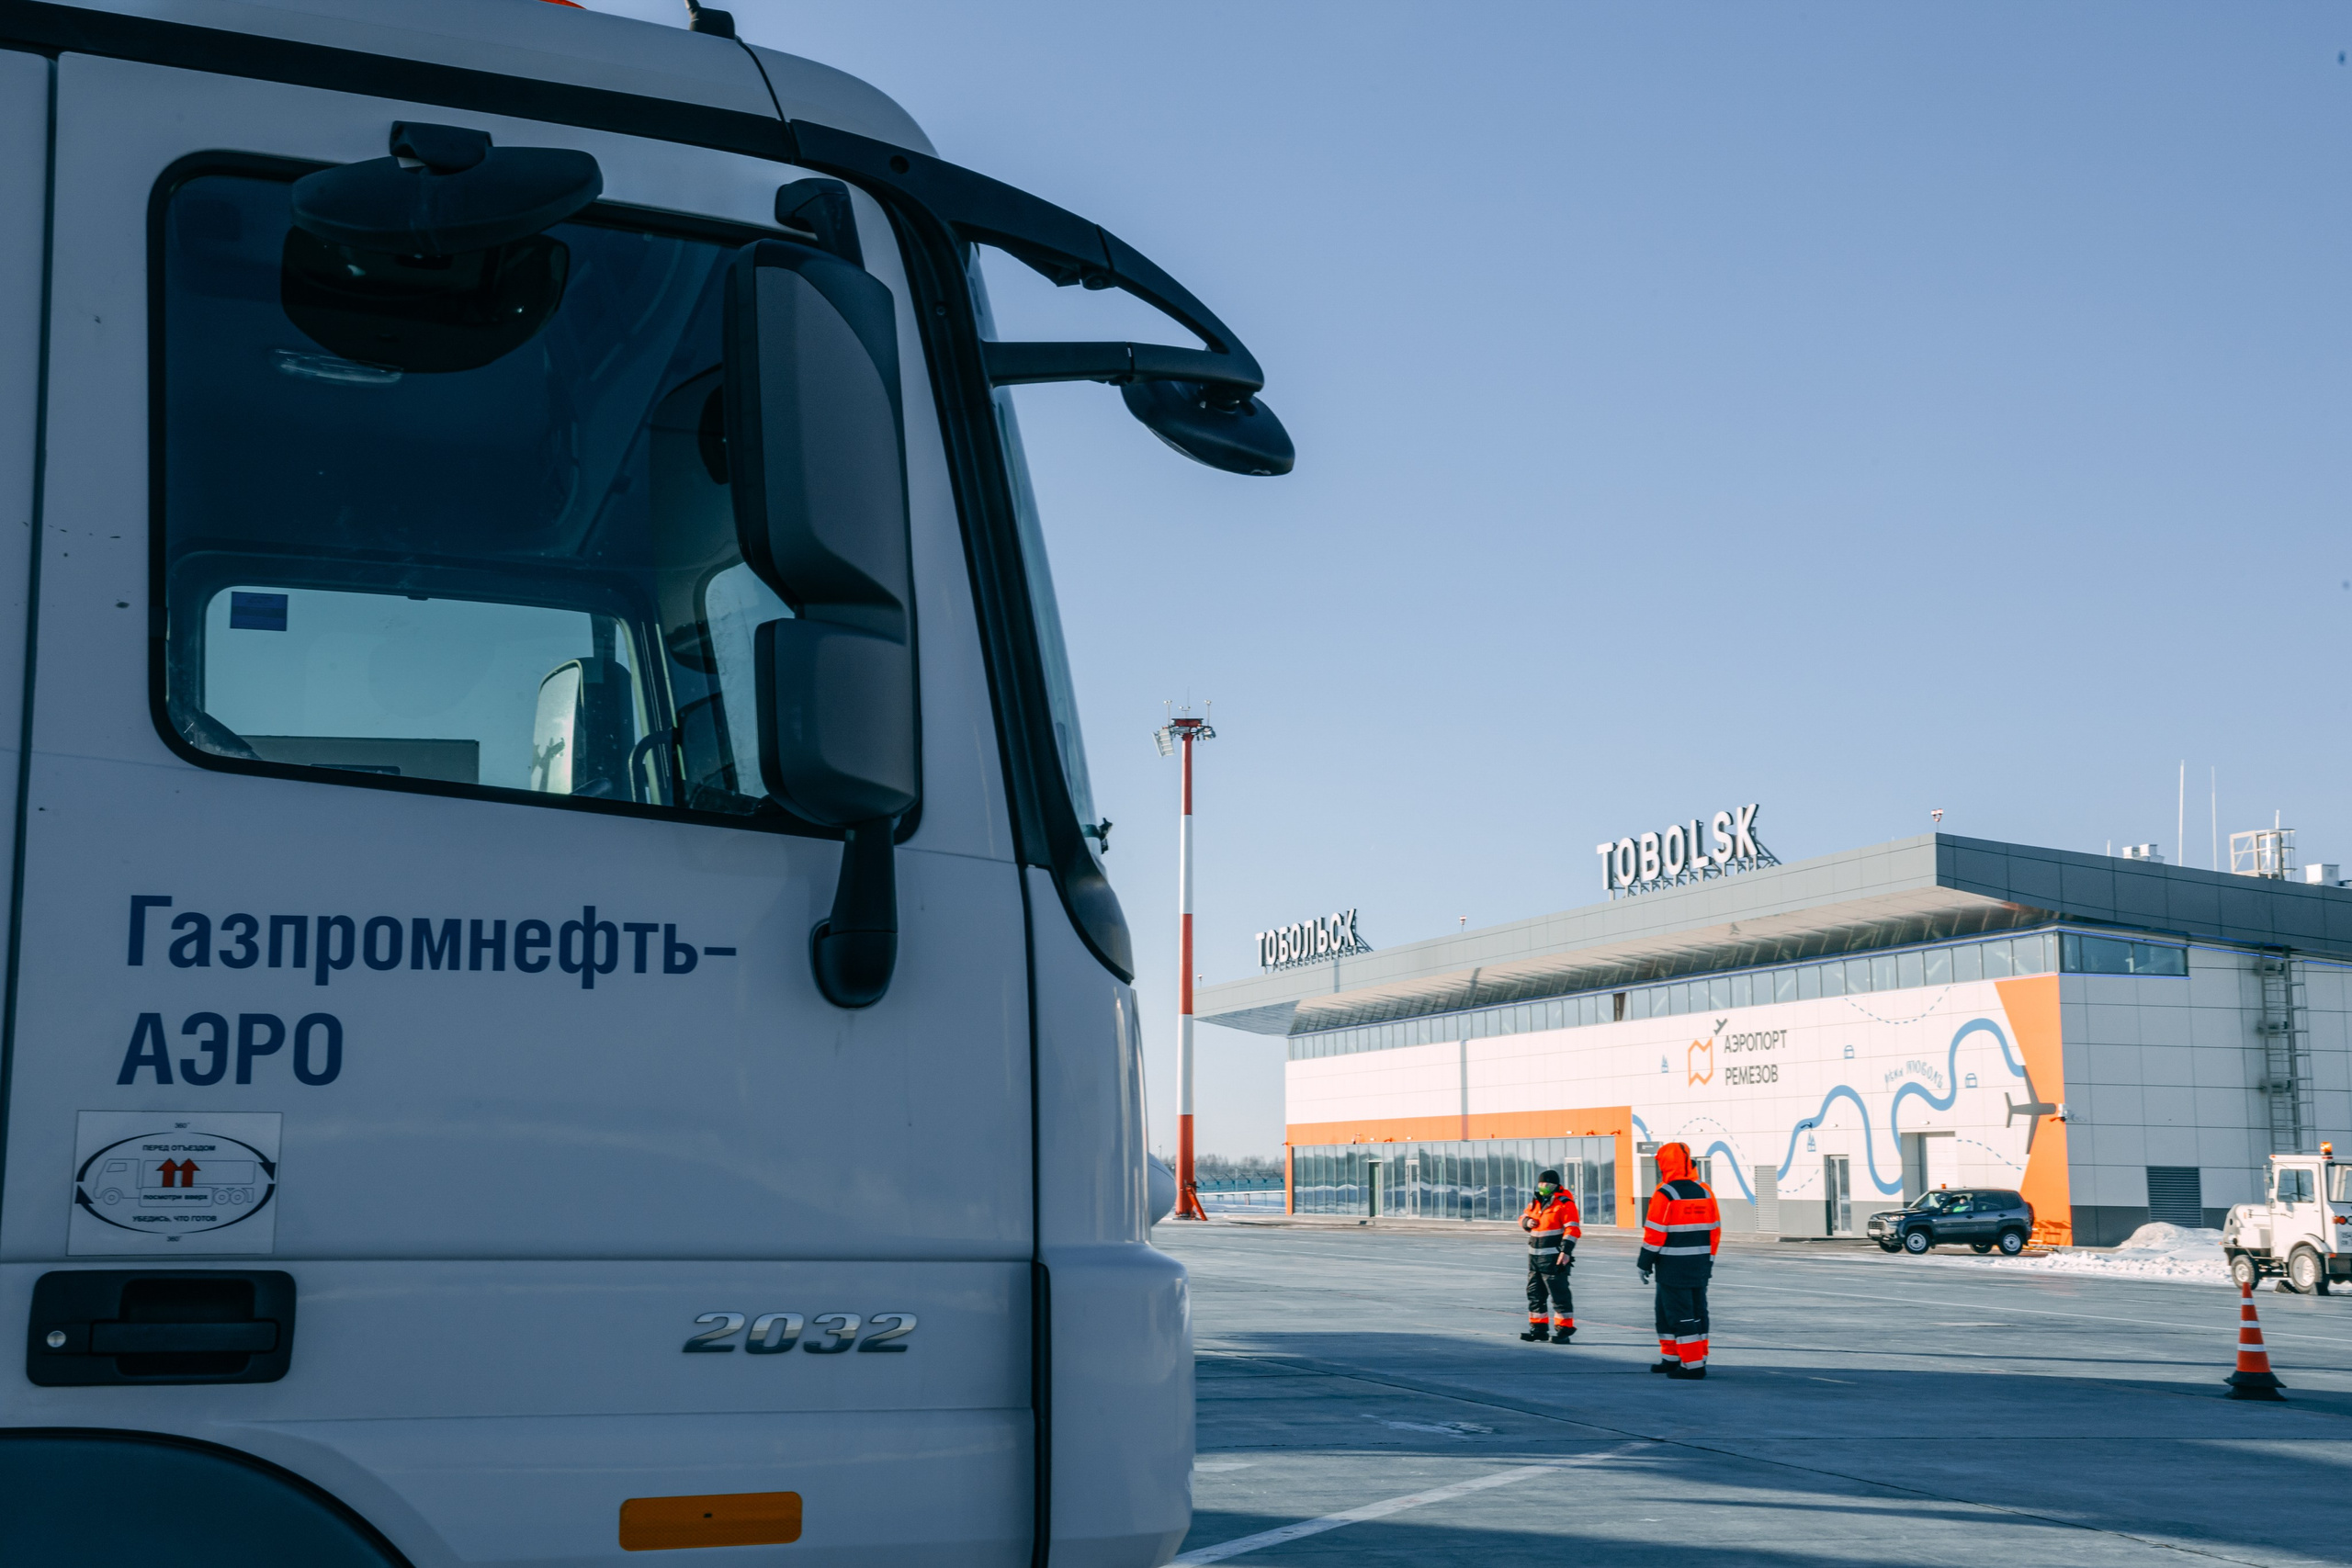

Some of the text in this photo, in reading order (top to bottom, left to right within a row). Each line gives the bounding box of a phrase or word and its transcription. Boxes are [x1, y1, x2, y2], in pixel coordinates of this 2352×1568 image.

[1597, 804, 1759, 890] TOBOLSK
[127, 894, 737, 989] Газпромнефть-
[1255, 908, 1358, 967] ТОБОЛЬСК
[116, 1011, 344, 1086] АЭРО
[1724, 1030, 1787, 1054] АЭРОПОРТ
[1724, 1065, 1779, 1086] РЕМЕЗОВ
[682, 1312, 918, 1355] 2032
